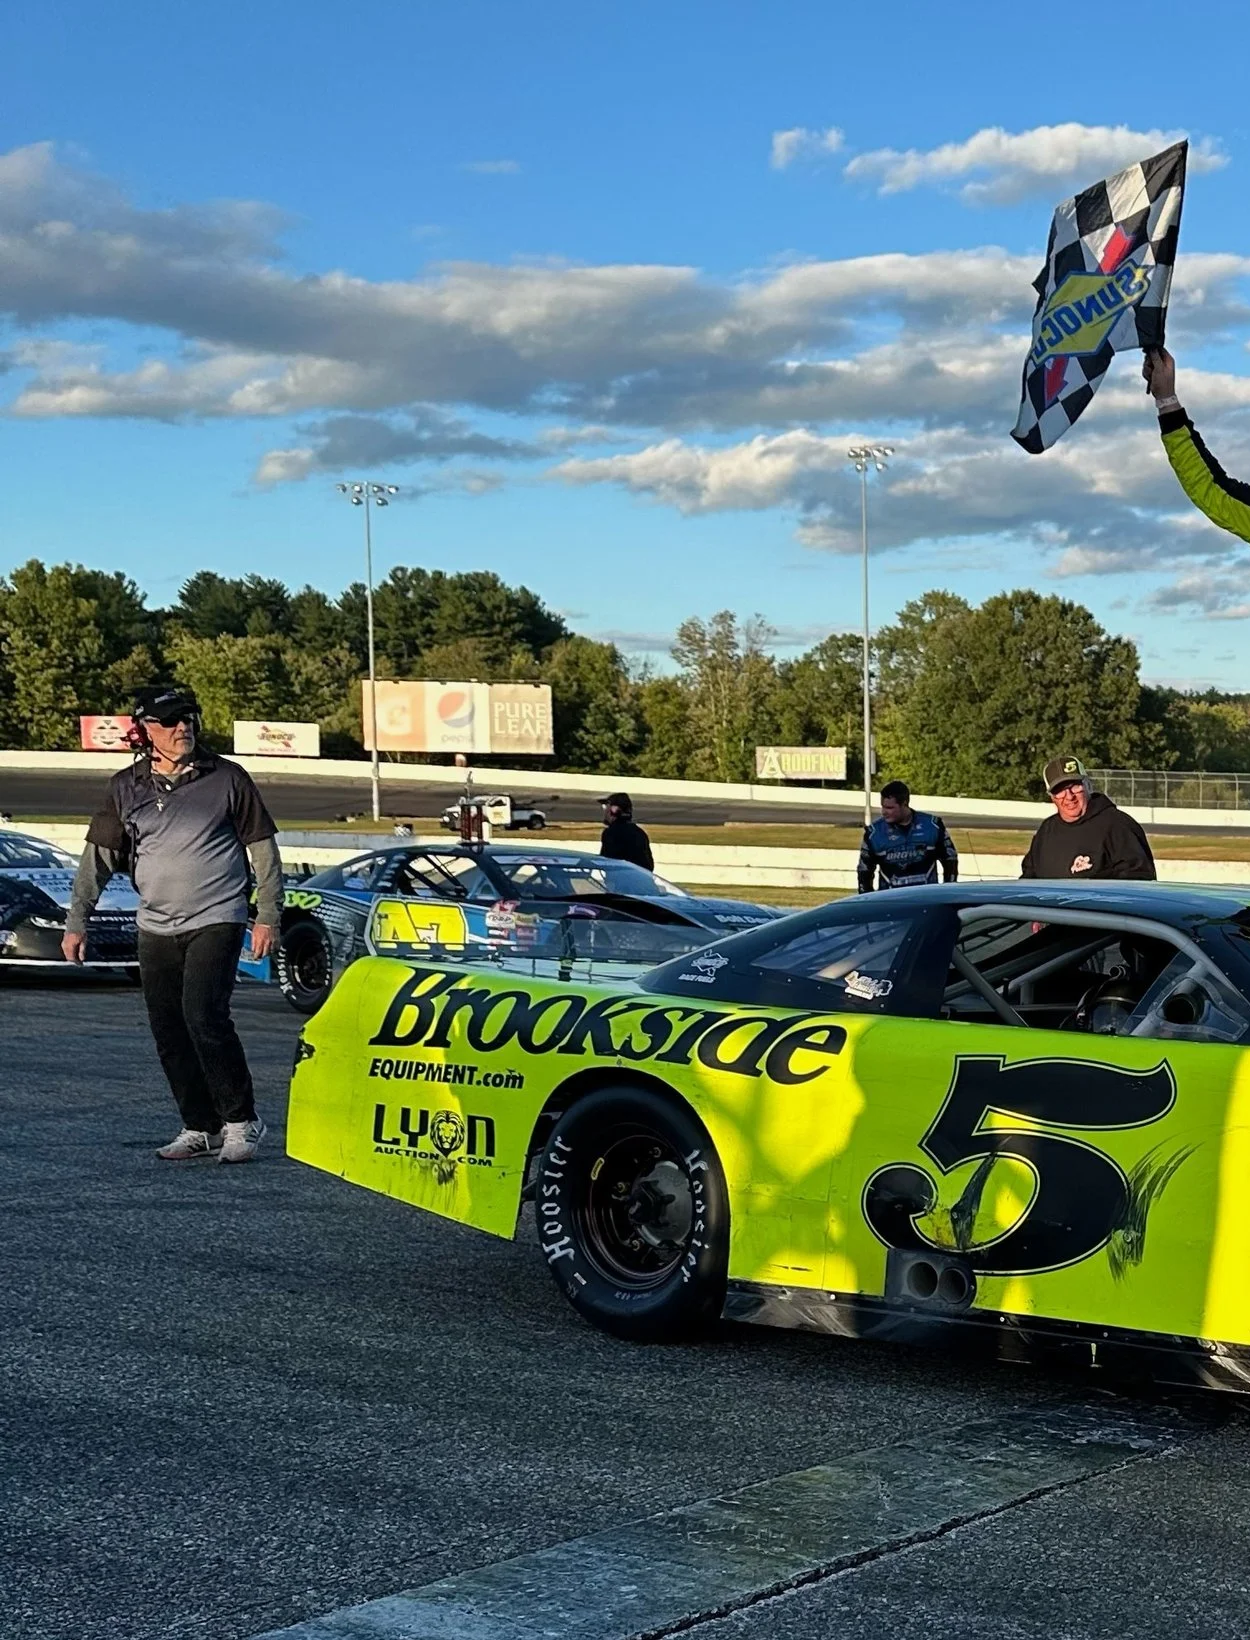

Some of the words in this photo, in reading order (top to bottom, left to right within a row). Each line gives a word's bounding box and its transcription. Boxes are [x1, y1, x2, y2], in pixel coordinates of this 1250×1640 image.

[494, 702, 547, 719] PURE
[494, 718, 547, 737] LEAF
[1063, 761, 1077, 773] 5
[368, 967, 849, 1086] Brookside
[369, 1057, 525, 1089] EQUIPMENT.com
[861, 1054, 1177, 1277] 5
[541, 1136, 575, 1264] Hoosier
